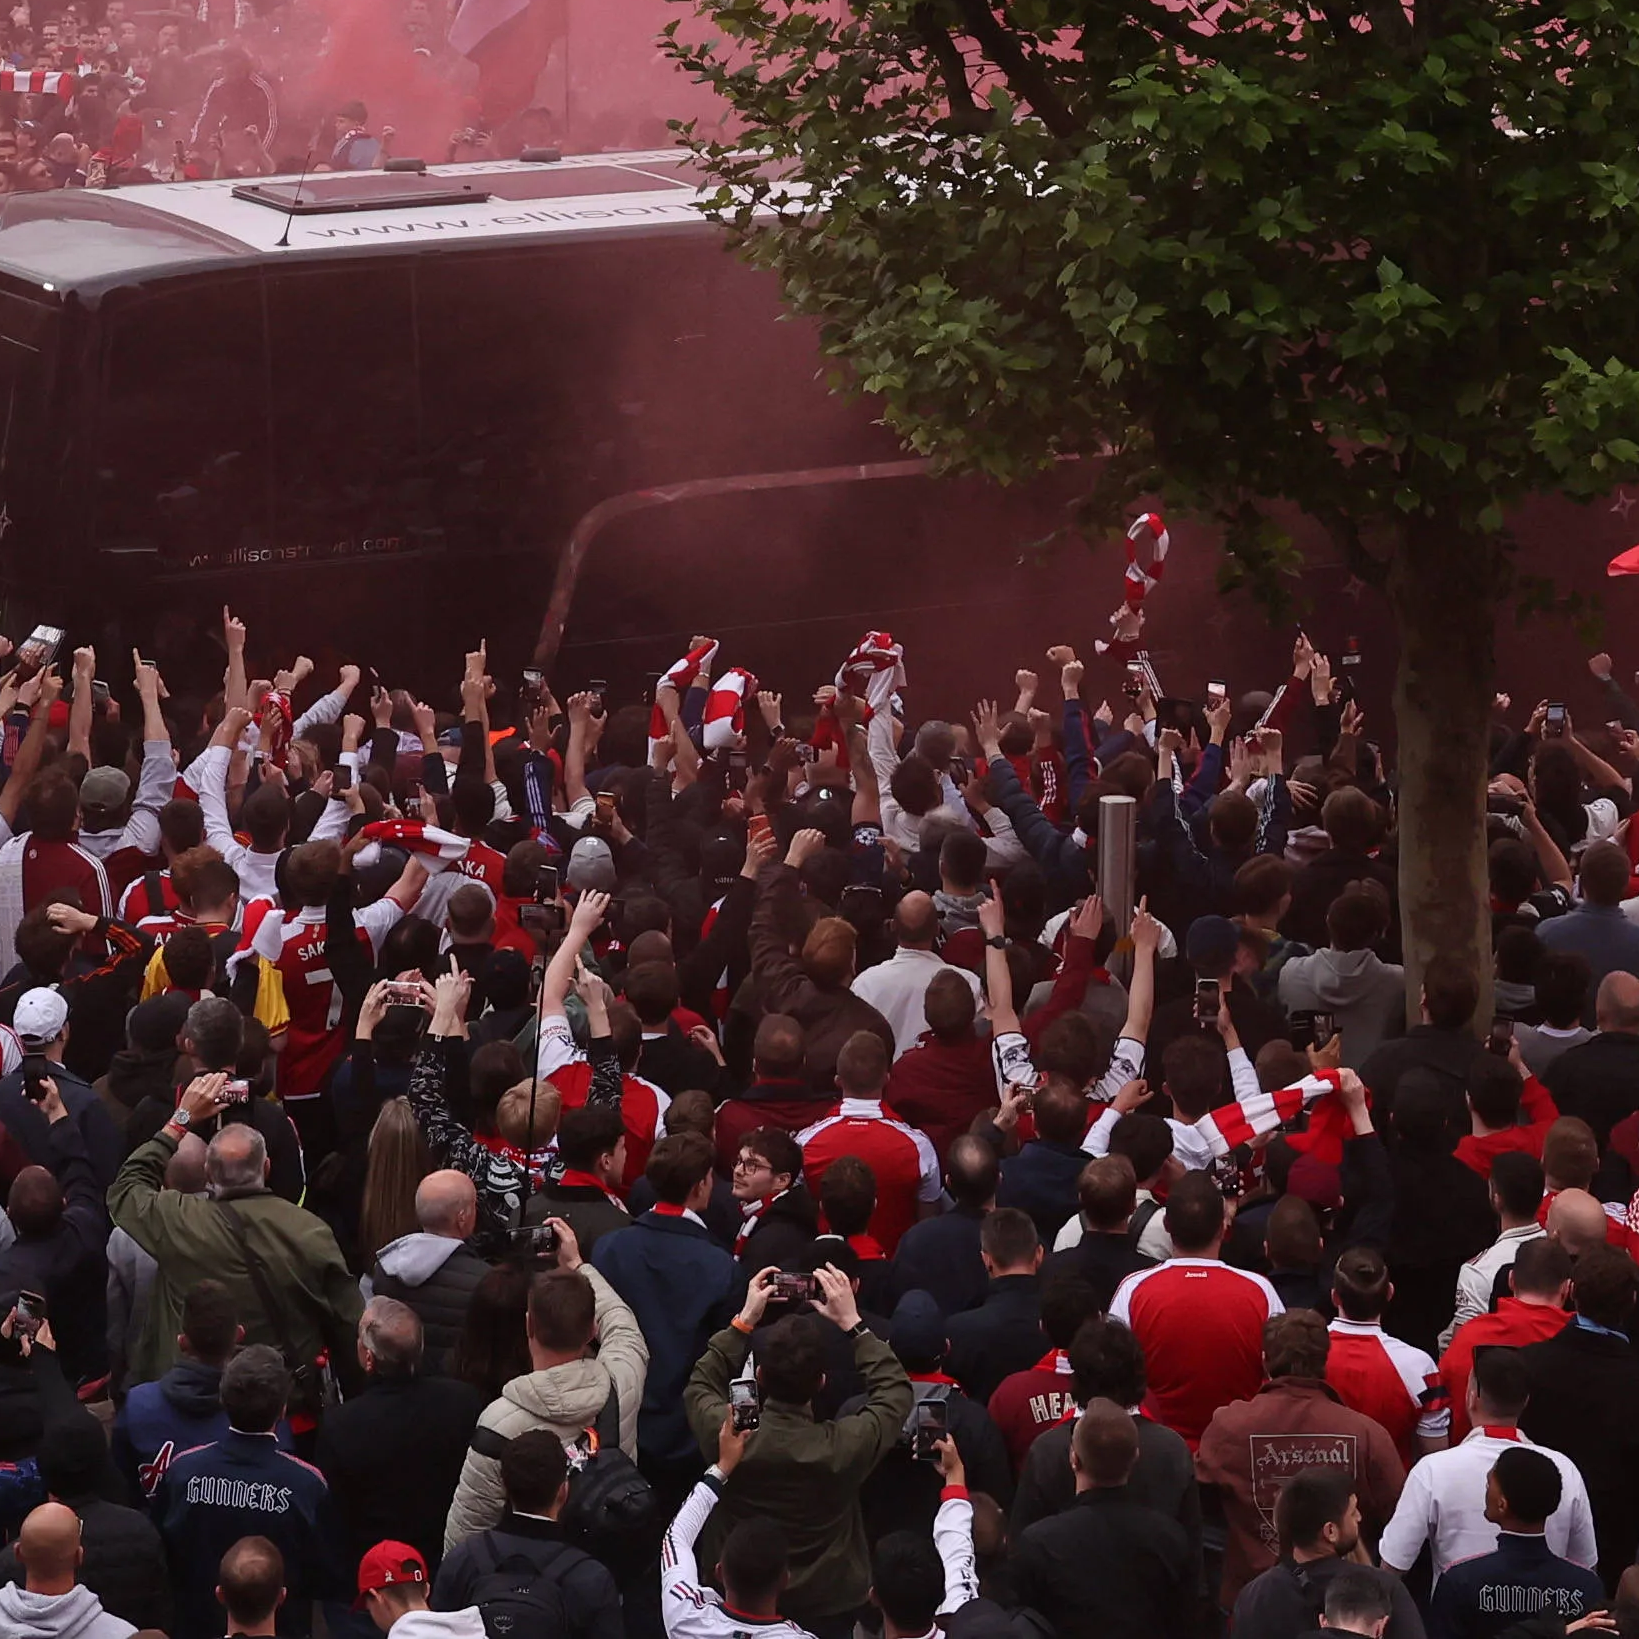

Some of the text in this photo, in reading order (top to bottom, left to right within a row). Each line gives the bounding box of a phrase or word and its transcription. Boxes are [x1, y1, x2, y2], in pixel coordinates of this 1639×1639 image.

[297, 941, 325, 962] SAK
[1256, 1440, 1350, 1467] Arsenal
[186, 1475, 293, 1514] GUNNERS
